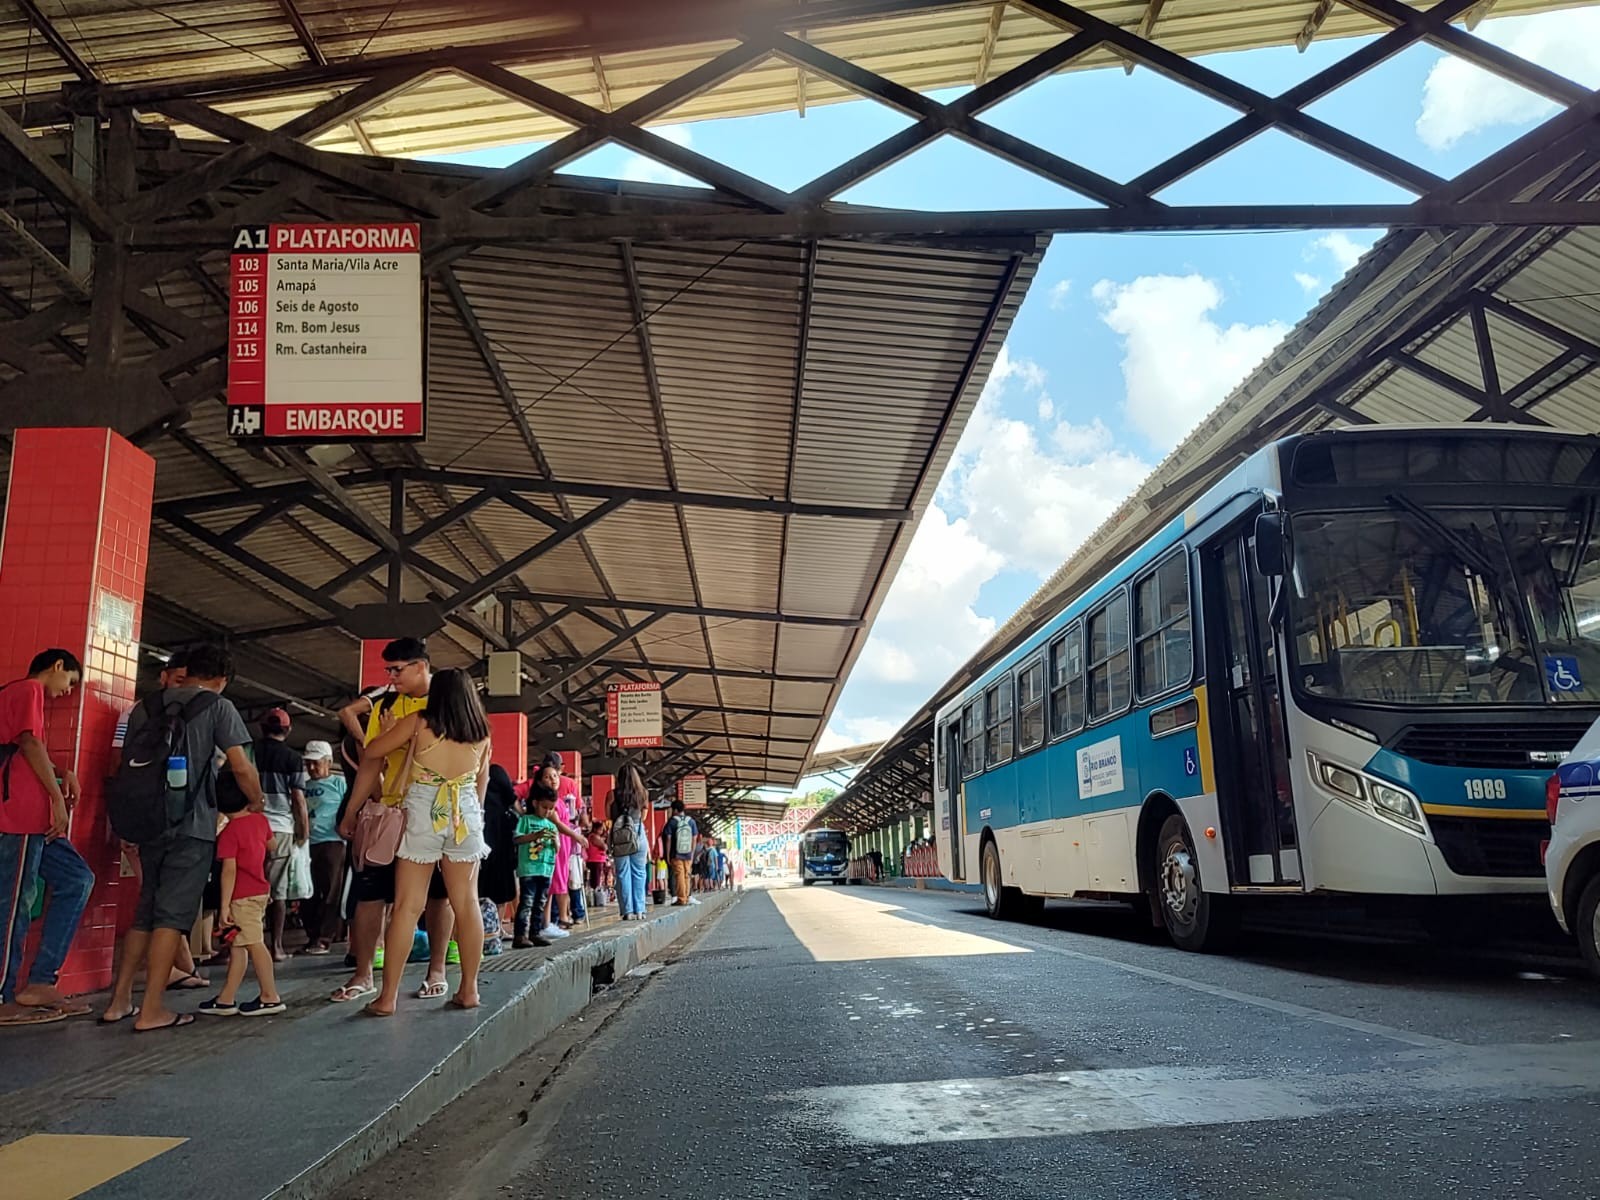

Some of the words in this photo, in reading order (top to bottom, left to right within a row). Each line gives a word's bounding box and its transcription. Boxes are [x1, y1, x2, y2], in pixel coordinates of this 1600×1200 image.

[234, 229, 269, 249] A1
[277, 228, 415, 249] PLATAFORMA
[239, 258, 259, 272] 103
[277, 258, 308, 271] Santa
[312, 258, 370, 272] Maria/Vila
[373, 259, 399, 271] Acre
[238, 279, 259, 293] 105
[276, 279, 316, 294] Amapá
[237, 300, 259, 314] 106
[276, 300, 298, 312] Seis
[301, 300, 316, 312] de
[319, 300, 359, 315] Agosto
[236, 322, 258, 335] 114
[276, 322, 298, 334] Rm.
[301, 322, 327, 334] Bom
[330, 322, 360, 334] Jesus
[236, 343, 258, 357] 115
[275, 343, 298, 355] Rm.
[301, 342, 367, 355] Castanheira
[286, 409, 404, 434] EMBARQUE
[620, 683, 660, 691] PLATAFORMA
[624, 738, 657, 746] EMBARQUE
[1099, 755, 1116, 768] BRANCO
[1464, 779, 1506, 799] 1989
